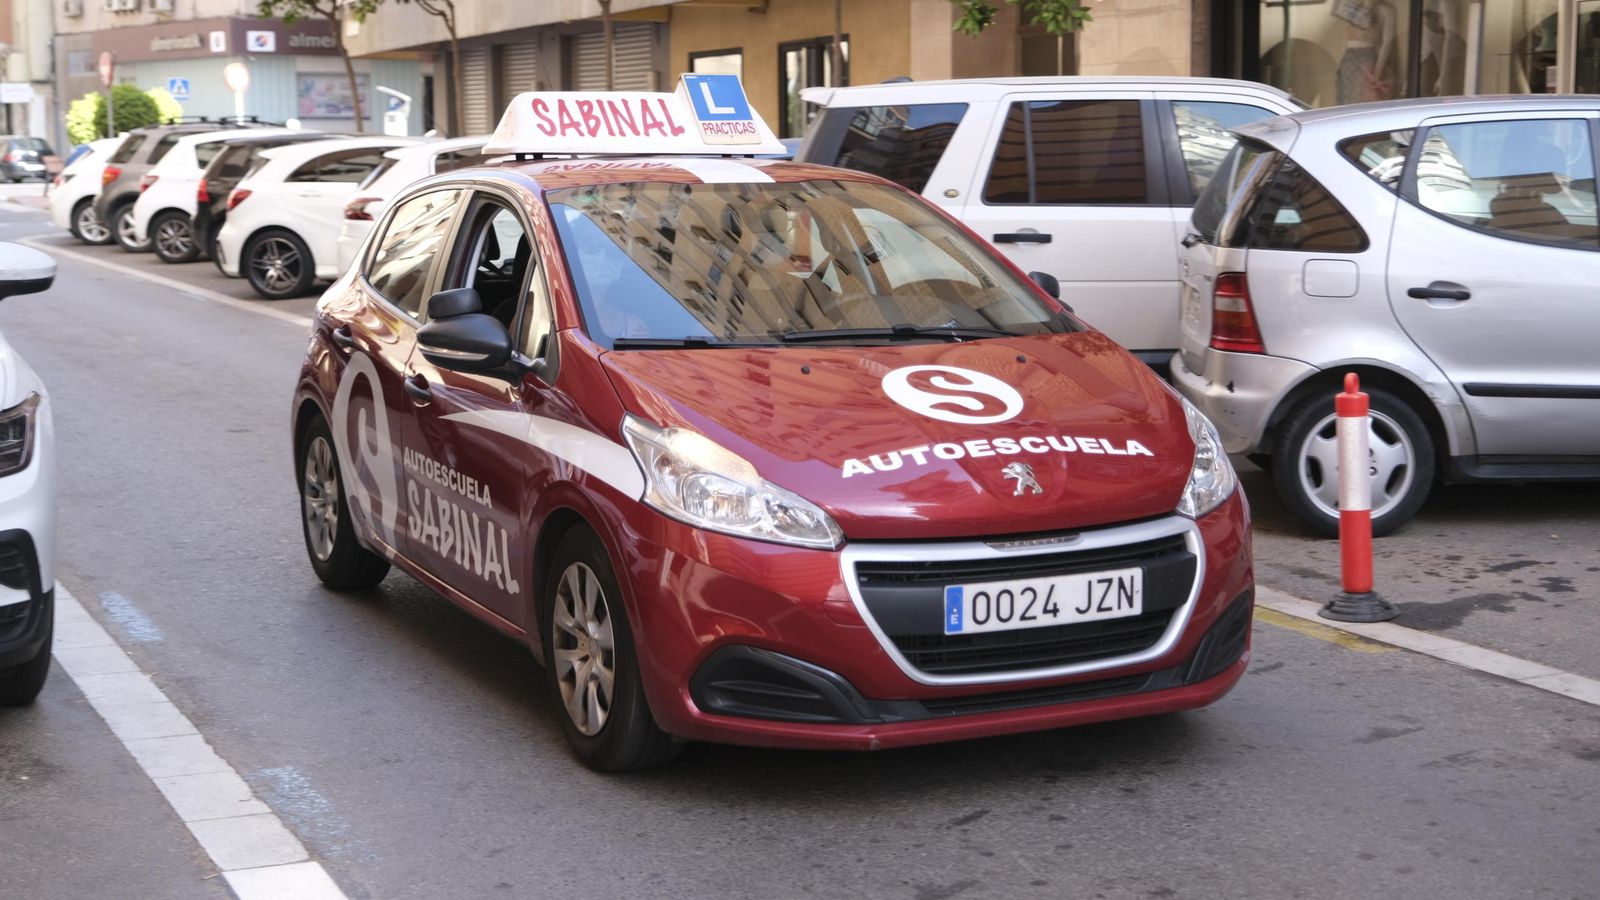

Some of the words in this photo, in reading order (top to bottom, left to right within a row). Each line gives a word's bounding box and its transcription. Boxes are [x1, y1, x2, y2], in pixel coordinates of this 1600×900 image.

[531, 98, 685, 137] SABINAL
[700, 82, 736, 114] L
[702, 122, 756, 135] PRACTICAS
[403, 446, 492, 508] AUTOESCUELA
[842, 436, 1154, 478] AUTOESCUELA
[406, 479, 520, 594] SABINAL
[971, 584, 1060, 626] 0024
[1074, 575, 1135, 615] JZN
